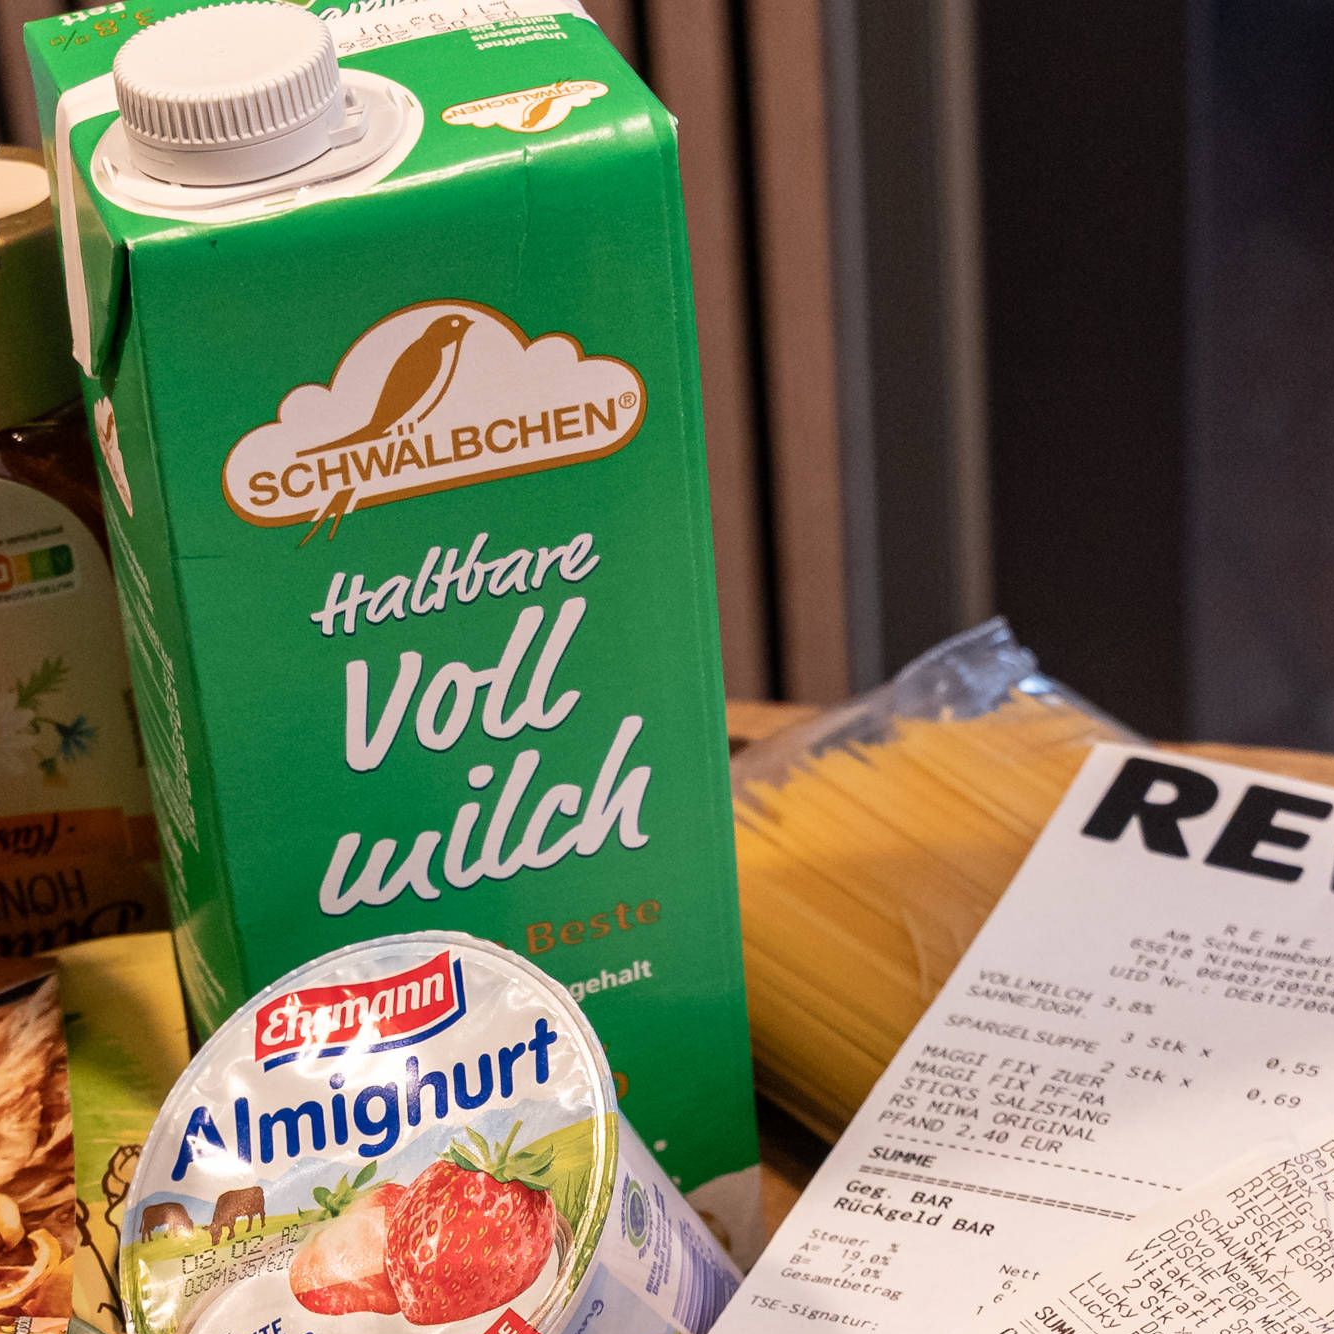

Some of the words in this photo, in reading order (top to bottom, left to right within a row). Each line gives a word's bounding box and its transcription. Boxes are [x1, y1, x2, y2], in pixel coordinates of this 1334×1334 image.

[475, 31, 568, 52] Ungeöffnet
[247, 395, 618, 508] SCHWÄLBCHEN
[310, 532, 599, 637] Haltbare
[344, 596, 586, 772] Voll
[318, 715, 652, 916] milch
[525, 896, 661, 956] Beste
[171, 1017, 558, 1182] Almighurt
[900, 1077, 980, 1101] STICKS
[990, 1093, 1111, 1125] SALZSTANG
[927, 1100, 979, 1120] MIWA
[992, 1112, 1095, 1143] ORIGINAL
[878, 1110, 945, 1132] PFAND
[1020, 1135, 1063, 1154] EUR
[868, 1146, 937, 1169] SUMME
[833, 1197, 943, 1226] Rückgeld
[951, 1218, 995, 1237] BAR
[846, 1180, 892, 1200] Geg.
[910, 1191, 953, 1209] BAR
[780, 1268, 903, 1301] Gesamtbetrag
[1286, 1244, 1333, 1284] ESPR
[1068, 1282, 1122, 1329] Lucky
[1086, 1271, 1139, 1318] Lucky
